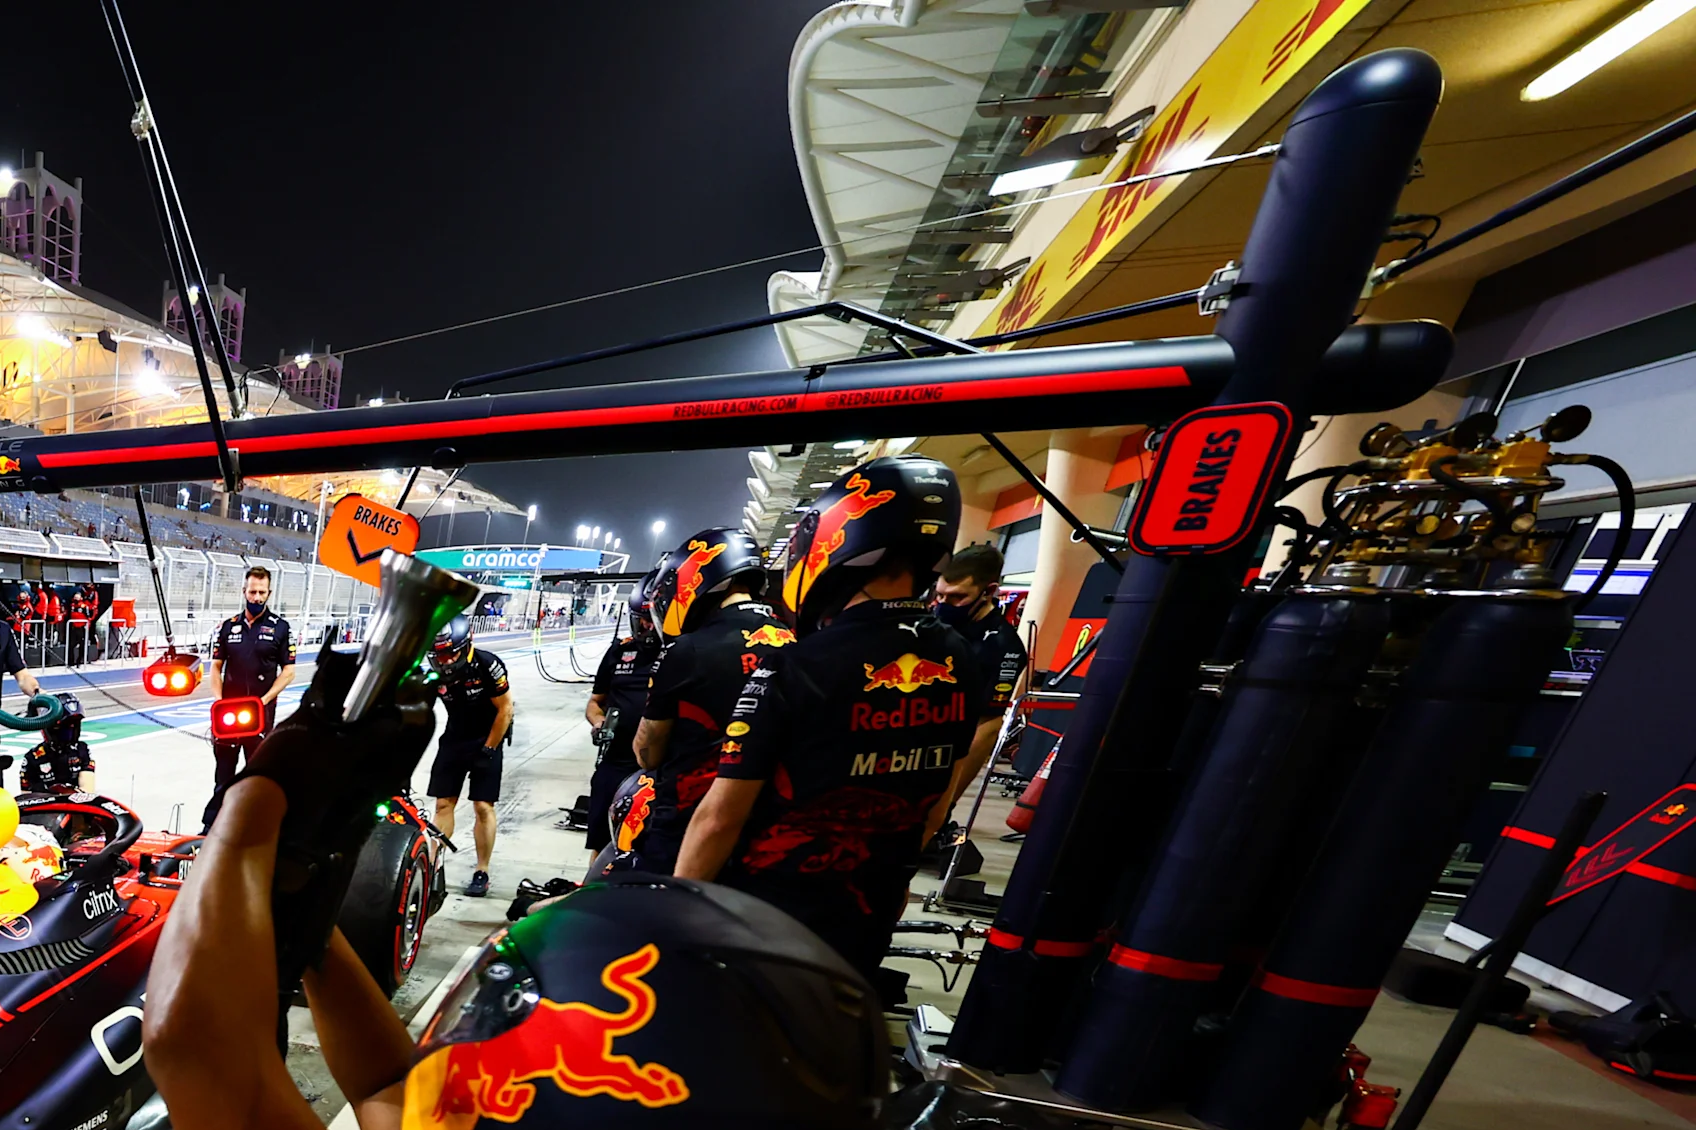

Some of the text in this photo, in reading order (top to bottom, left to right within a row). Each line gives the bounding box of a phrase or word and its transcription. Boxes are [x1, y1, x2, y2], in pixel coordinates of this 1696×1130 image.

[672, 387, 945, 418] REDBULLRACING.COM @REDBULLRACING
[1172, 428, 1243, 532] BRAKES
[354, 504, 402, 536] BRAKES
[462, 551, 542, 568] aramco
[882, 601, 925, 609] HONDA
[850, 692, 965, 732] Red Bull
[850, 748, 922, 777] Mobil
[83, 884, 120, 919] citrix
[0, 916, 28, 938] E
